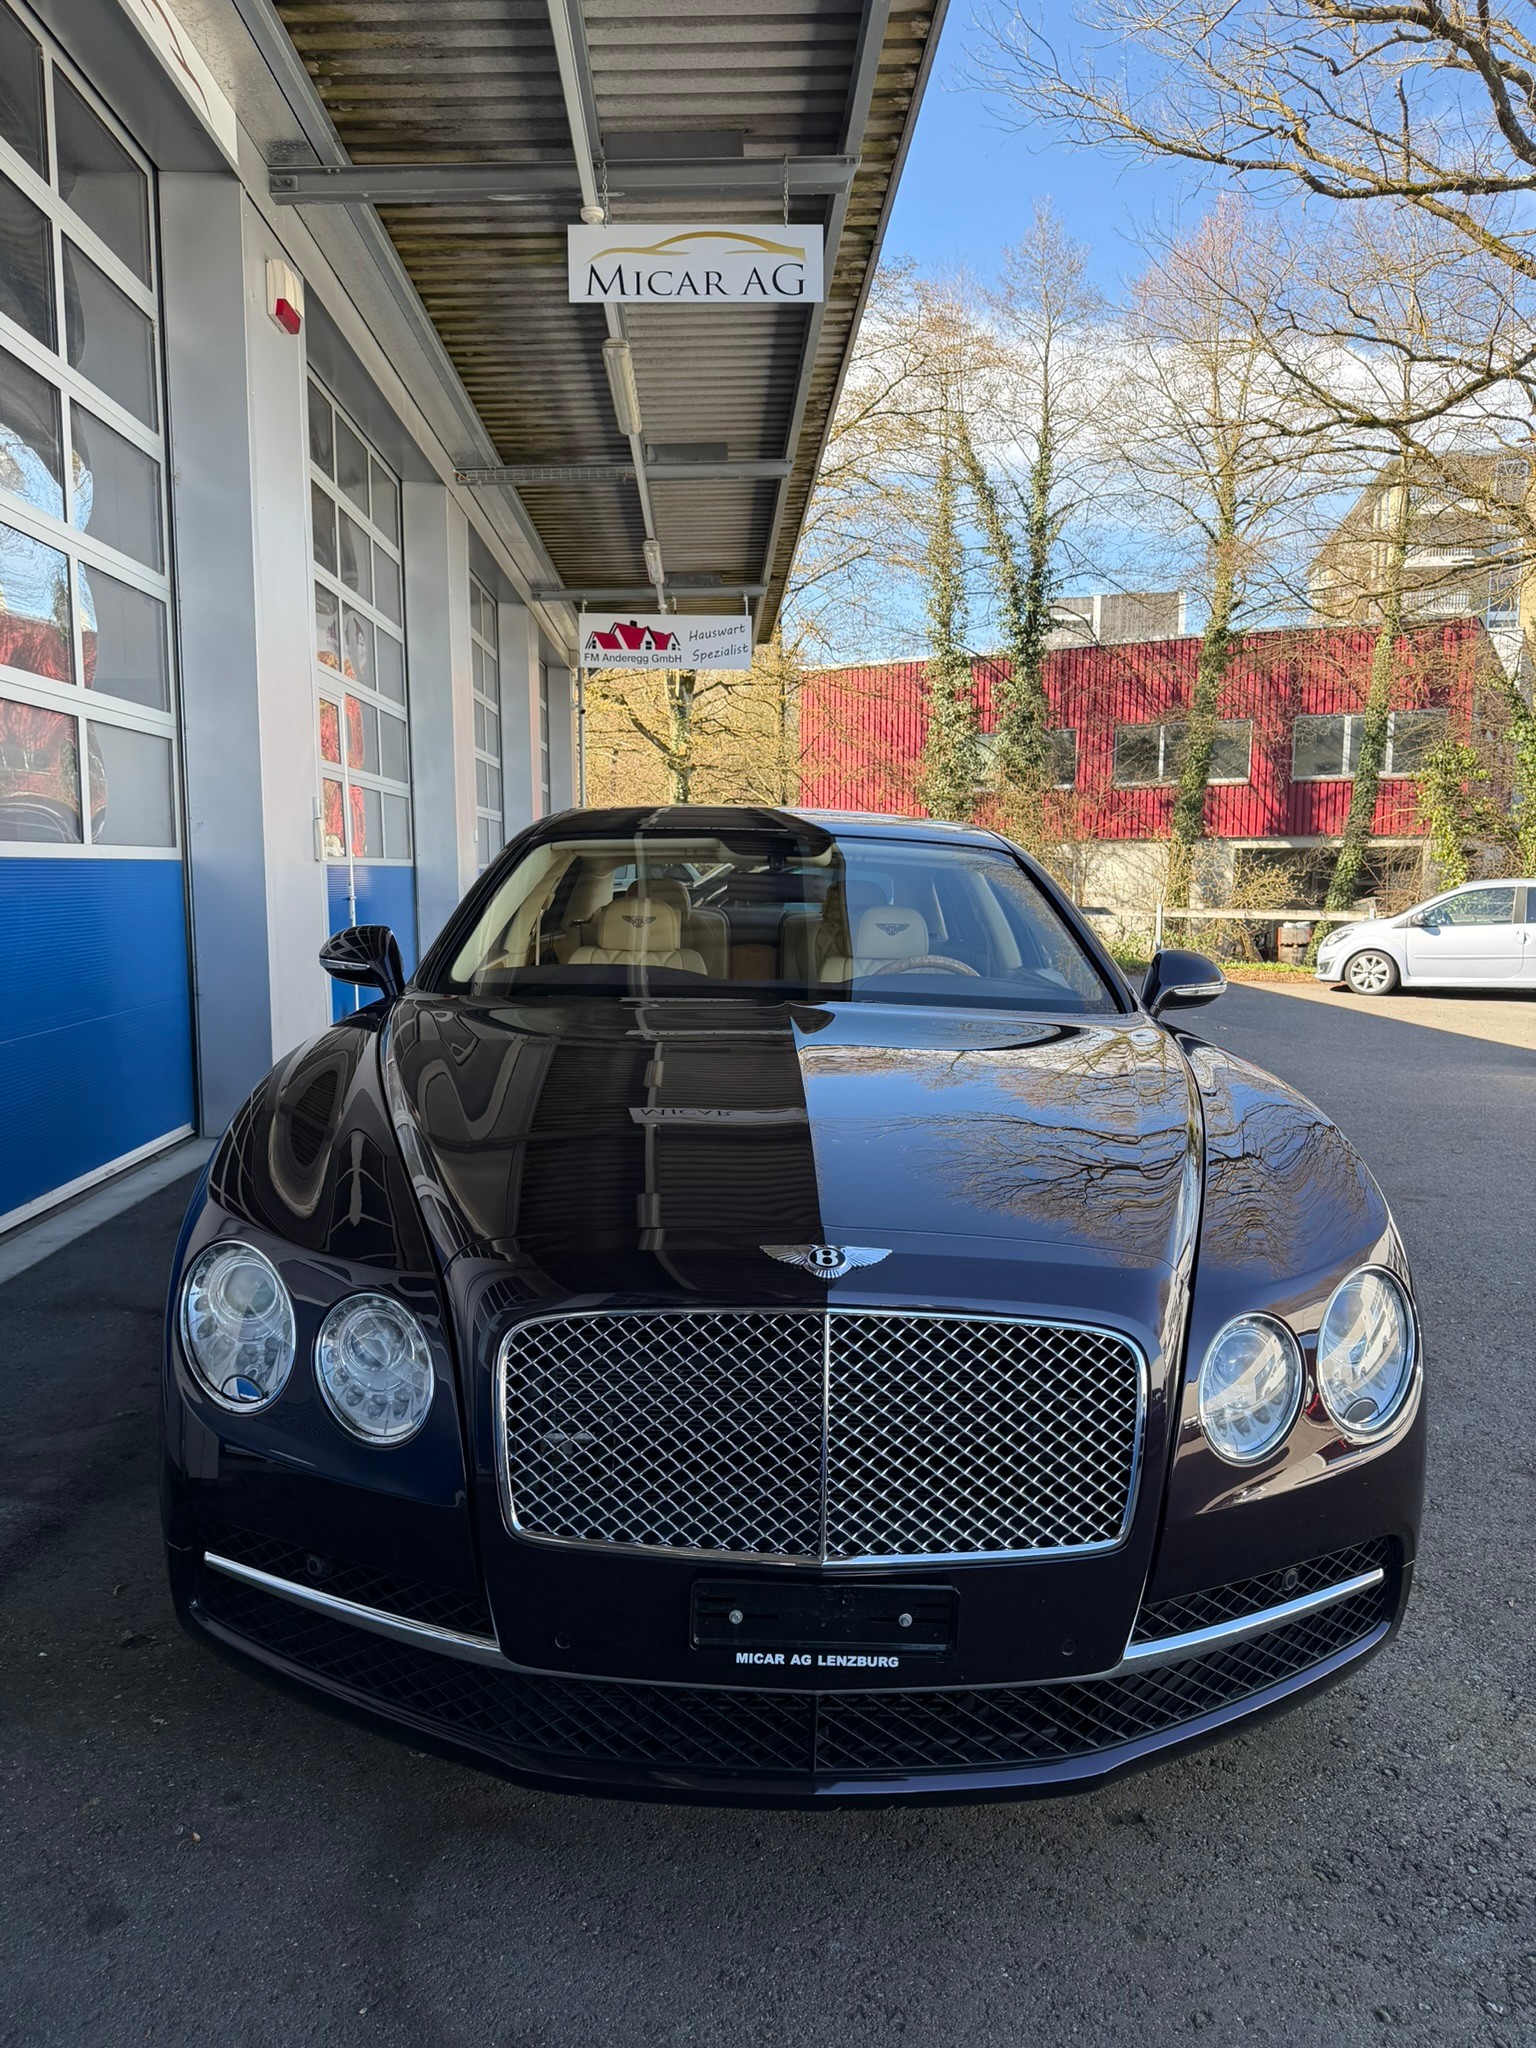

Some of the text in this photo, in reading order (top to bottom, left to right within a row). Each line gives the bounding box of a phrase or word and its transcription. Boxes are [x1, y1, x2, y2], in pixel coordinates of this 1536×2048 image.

[740, 263, 805, 296] AG
[688, 624, 746, 642] Hauswart
[584, 653, 682, 664] FM Anderegg GmbH
[692, 644, 749, 663] Spezialist
[815, 1250, 839, 1267] B
[736, 1653, 899, 1668] MICAR AG LENZBURG
